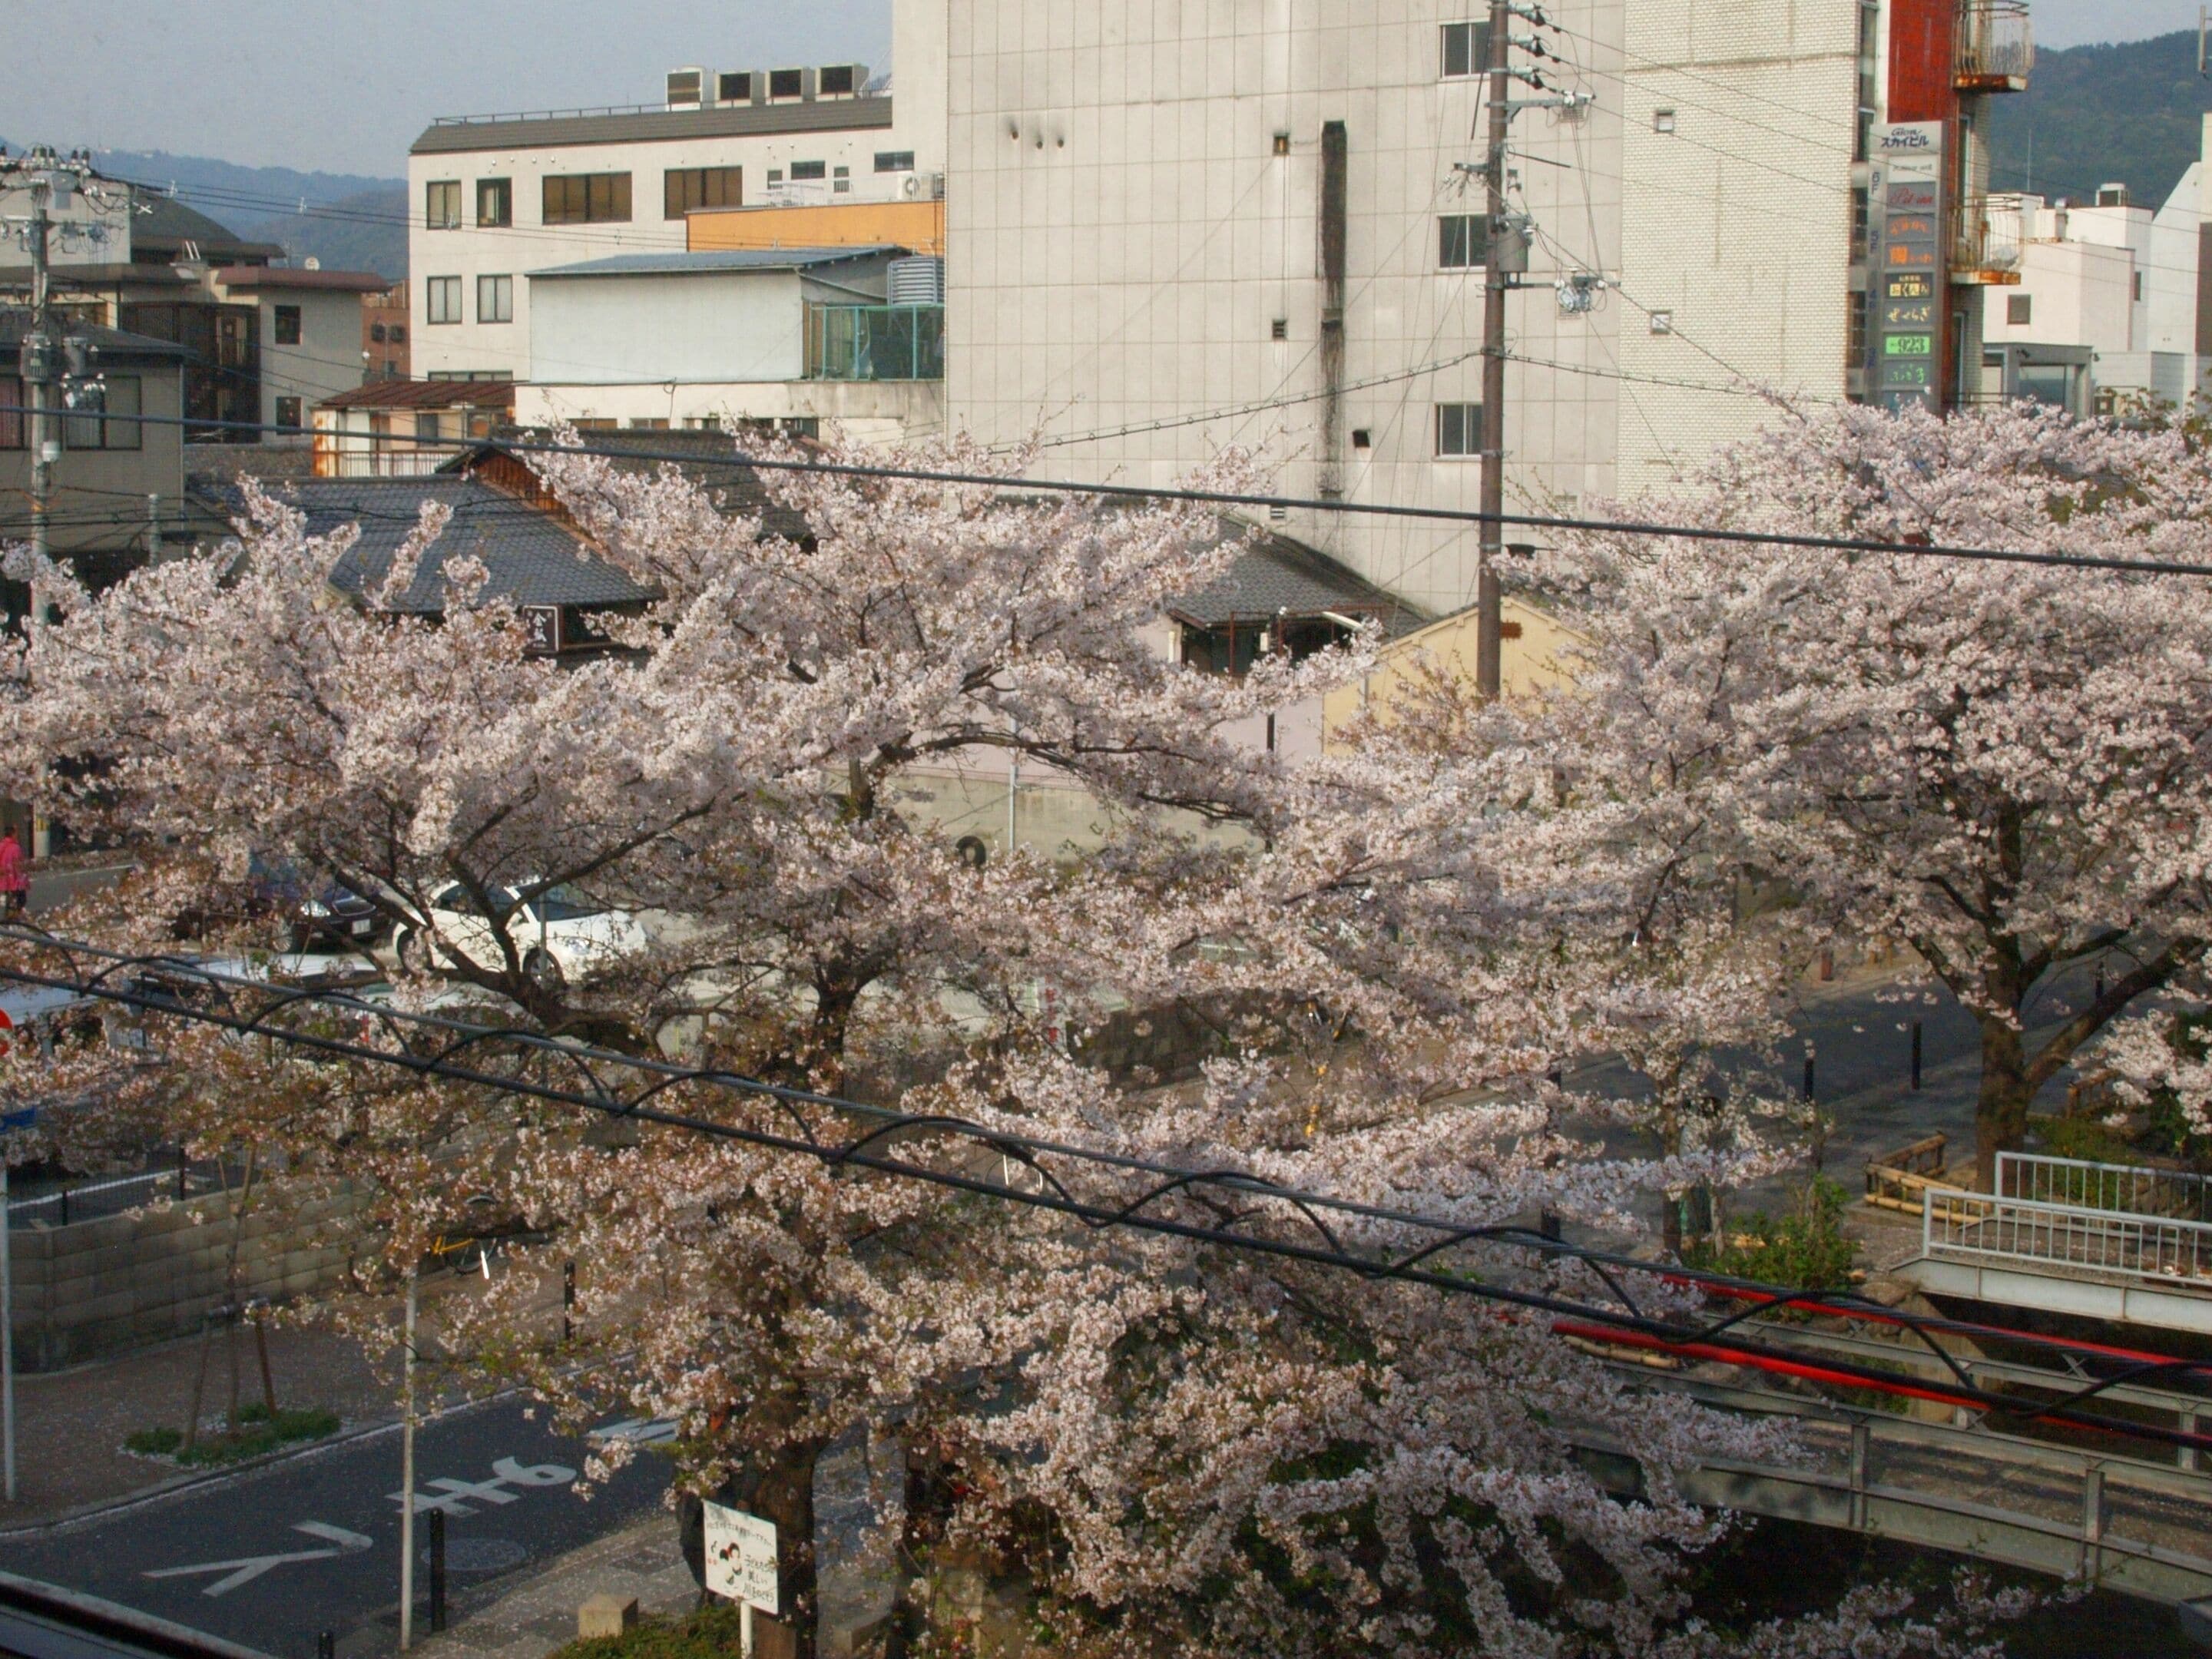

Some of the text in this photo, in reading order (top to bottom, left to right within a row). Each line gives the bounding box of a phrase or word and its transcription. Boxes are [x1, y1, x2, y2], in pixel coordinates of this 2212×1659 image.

[1881, 135, 1929, 148] スカイビル
